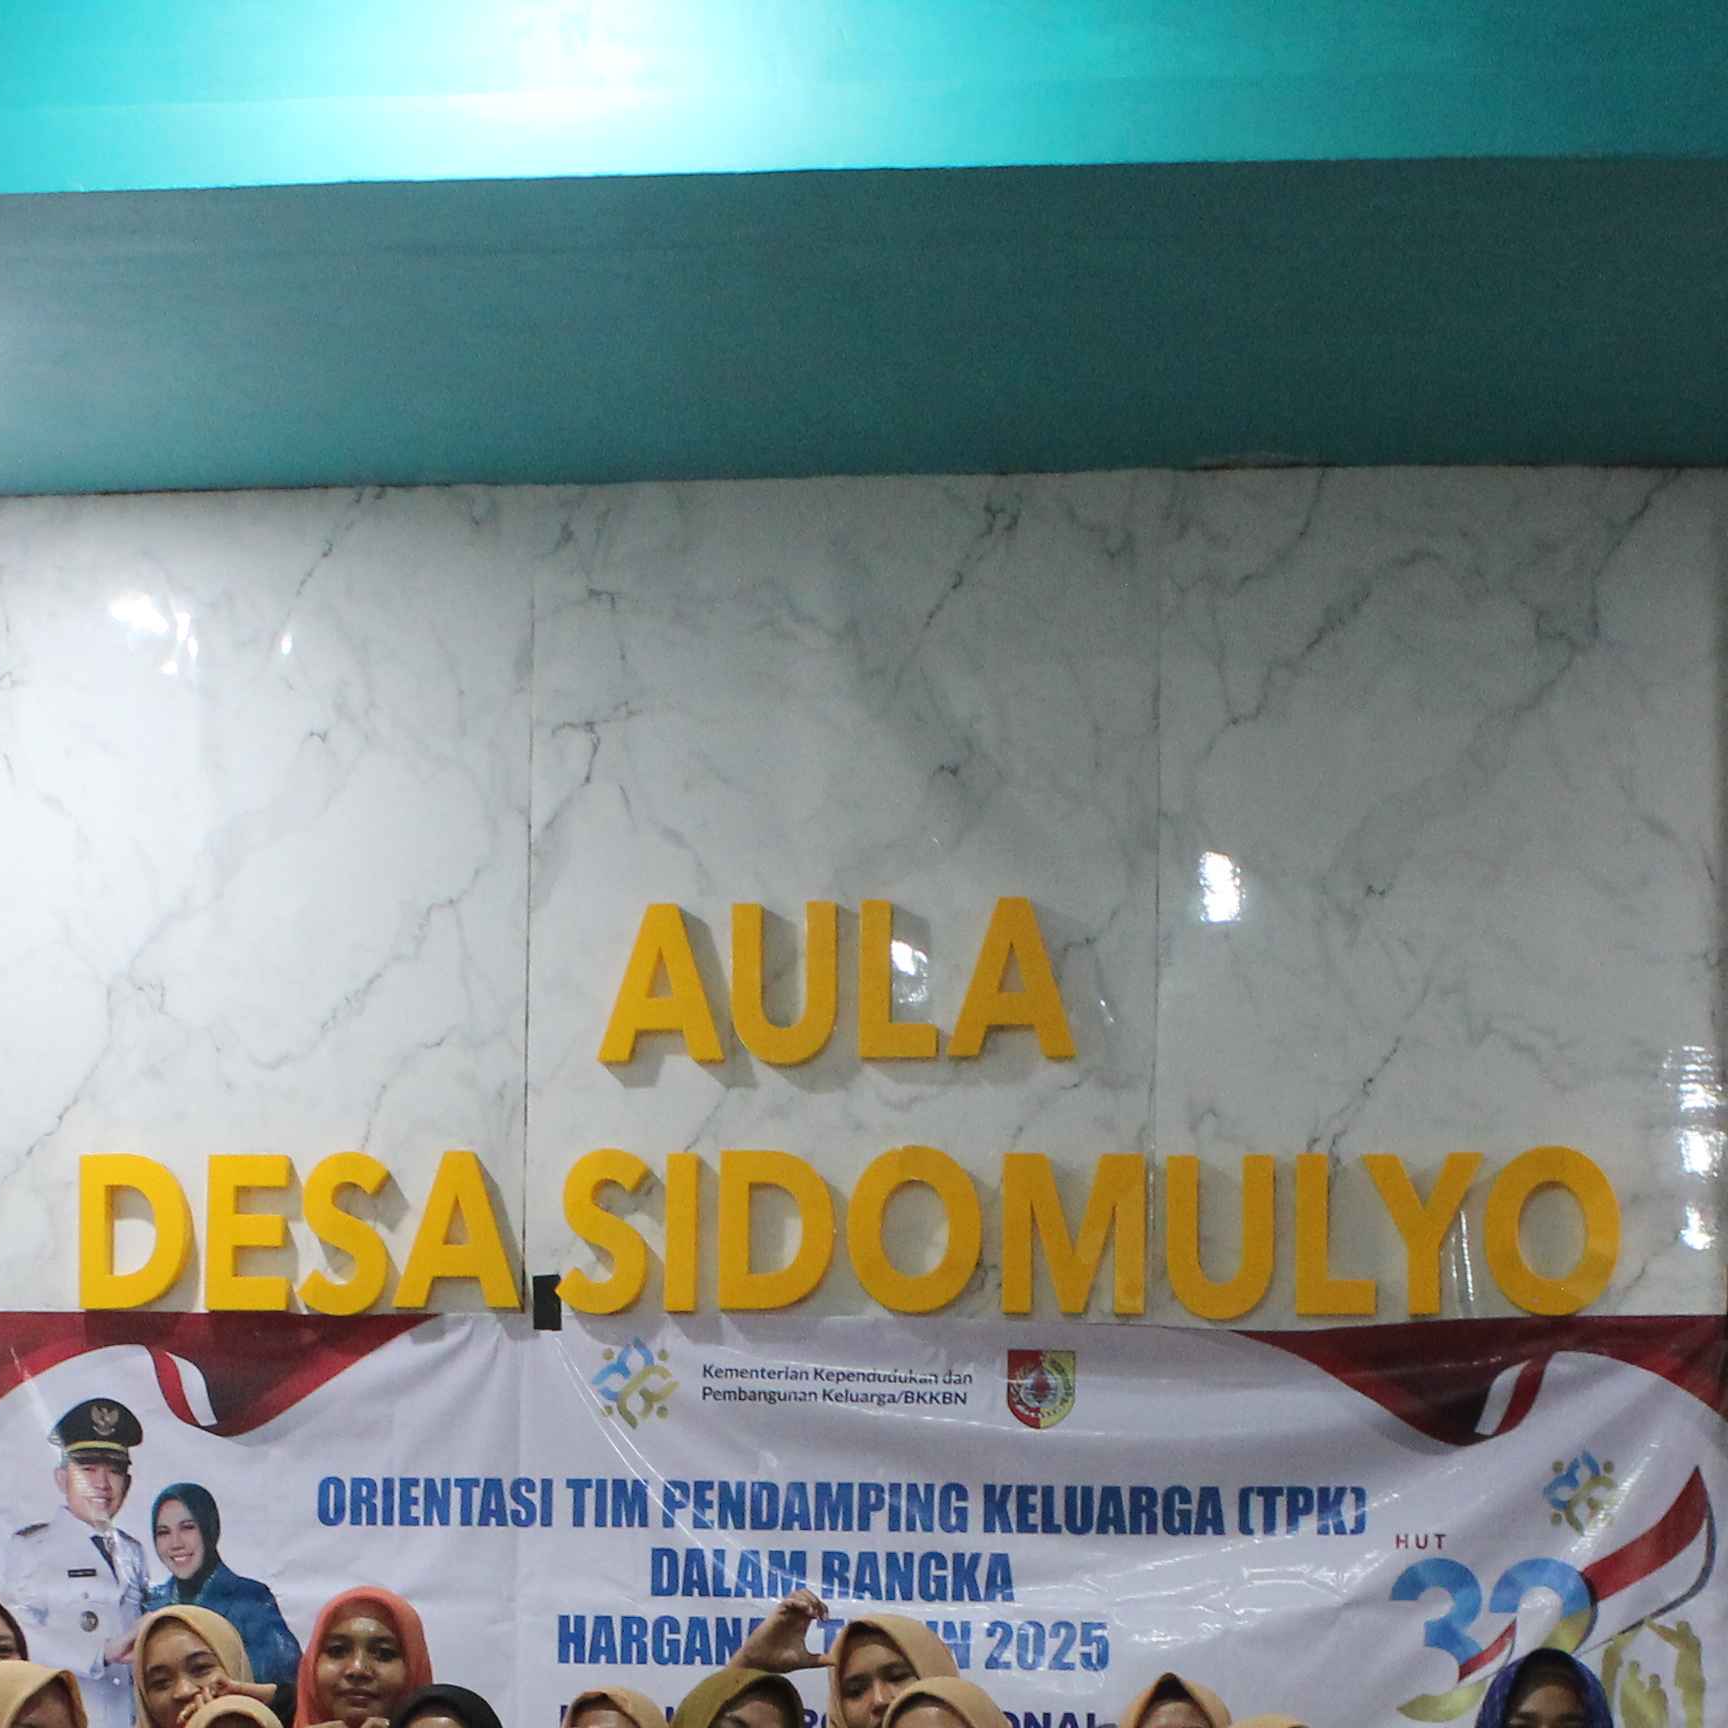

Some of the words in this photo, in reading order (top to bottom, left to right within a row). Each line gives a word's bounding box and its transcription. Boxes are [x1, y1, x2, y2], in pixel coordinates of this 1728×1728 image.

[597, 896, 1075, 1065] AULA
[77, 1149, 523, 1317] DESA
[556, 1144, 1621, 1318] SIDOMULYO
[701, 1364, 810, 1382] Kementerian
[942, 1370, 973, 1386] dan
[701, 1386, 819, 1406] Pembangunan
[821, 1387, 968, 1407] Keluarga/BKKBN
[317, 1475, 553, 1528] ORIENTASI
[566, 1478, 649, 1528] TIM
[661, 1480, 969, 1535] PENDAMPING
[982, 1483, 1225, 1536] KELUARGA
[1238, 1485, 1367, 1536] (TPK)
[1395, 1534, 1447, 1550] HUT
[650, 1547, 807, 1601] DALAM
[820, 1550, 1015, 1602] RANGKA
[984, 1620, 1110, 1671] 2025
